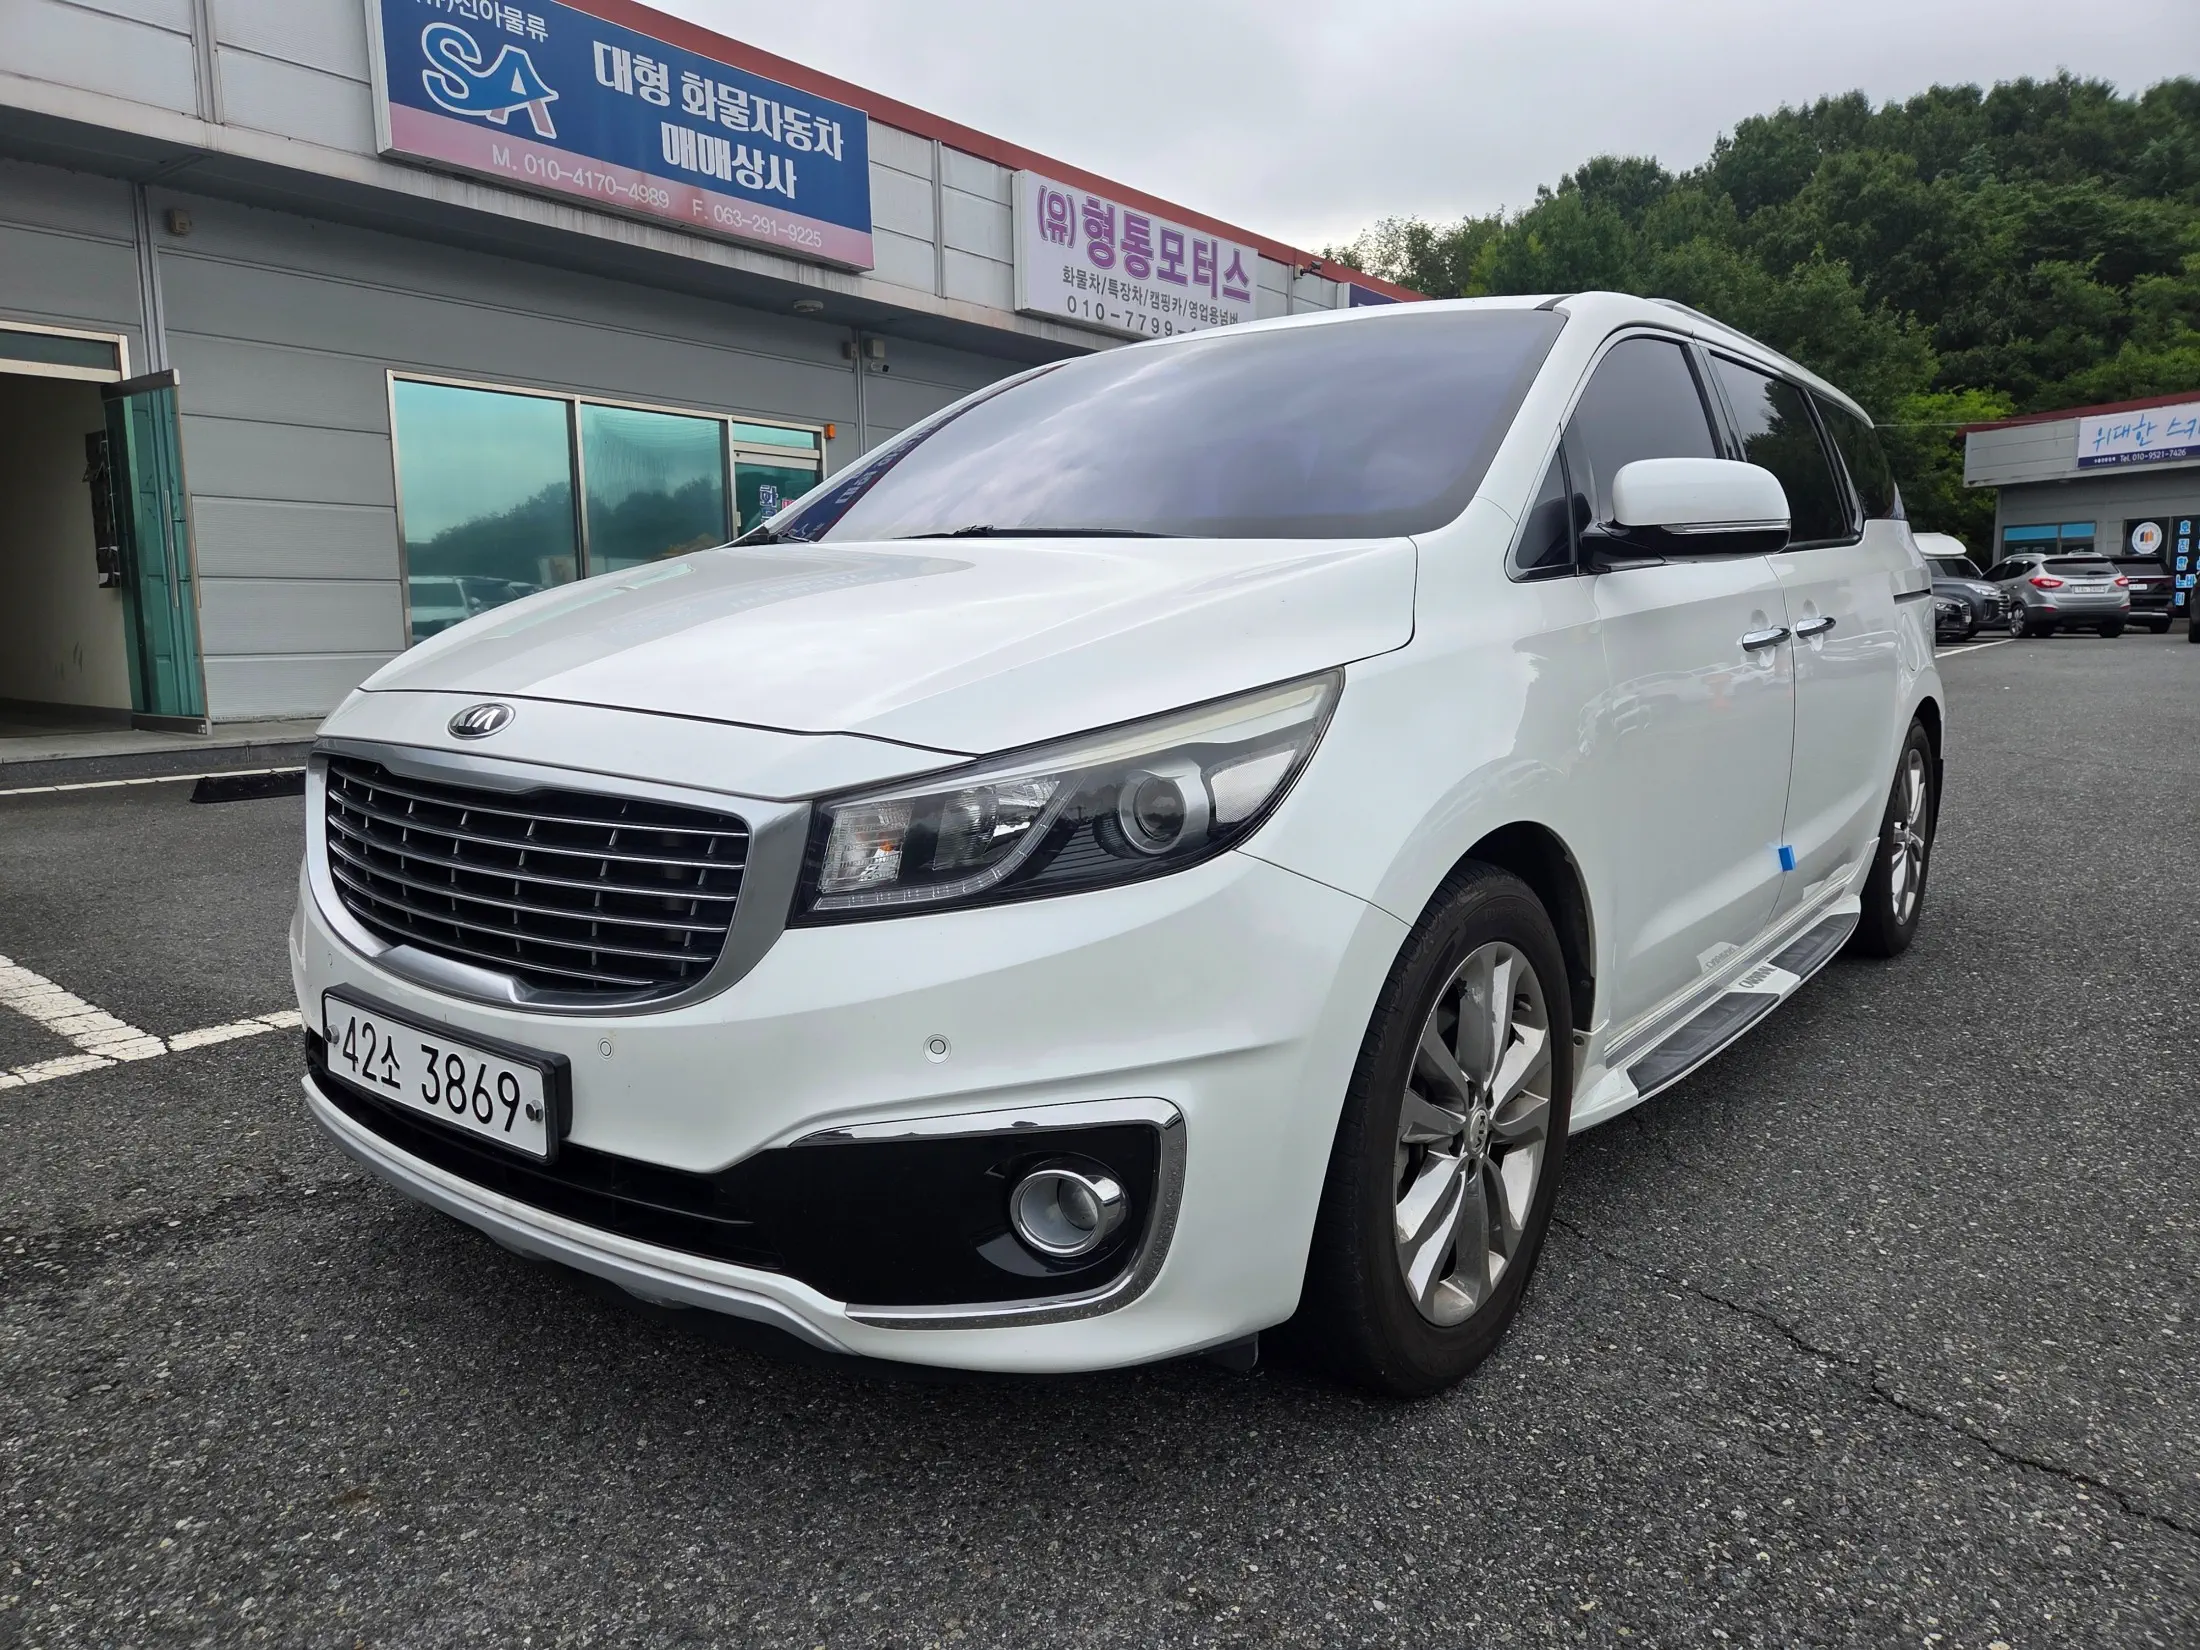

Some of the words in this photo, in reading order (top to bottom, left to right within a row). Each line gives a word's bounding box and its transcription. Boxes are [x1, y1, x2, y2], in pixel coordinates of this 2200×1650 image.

[593, 40, 670, 106] 대형
[681, 69, 844, 162] 화물자동차
[492, 143, 518, 171] M.
[523, 152, 671, 209] 010-4170-4989
[691, 199, 709, 221] F.
[712, 206, 824, 249] 063-291-9225
[661, 120, 798, 200] 매매상사
[1066, 295, 1197, 337] 010-7799-
[2092, 413, 2158, 452] 위대한
[342, 1016, 401, 1090] 42소
[420, 1043, 521, 1133] 3869
